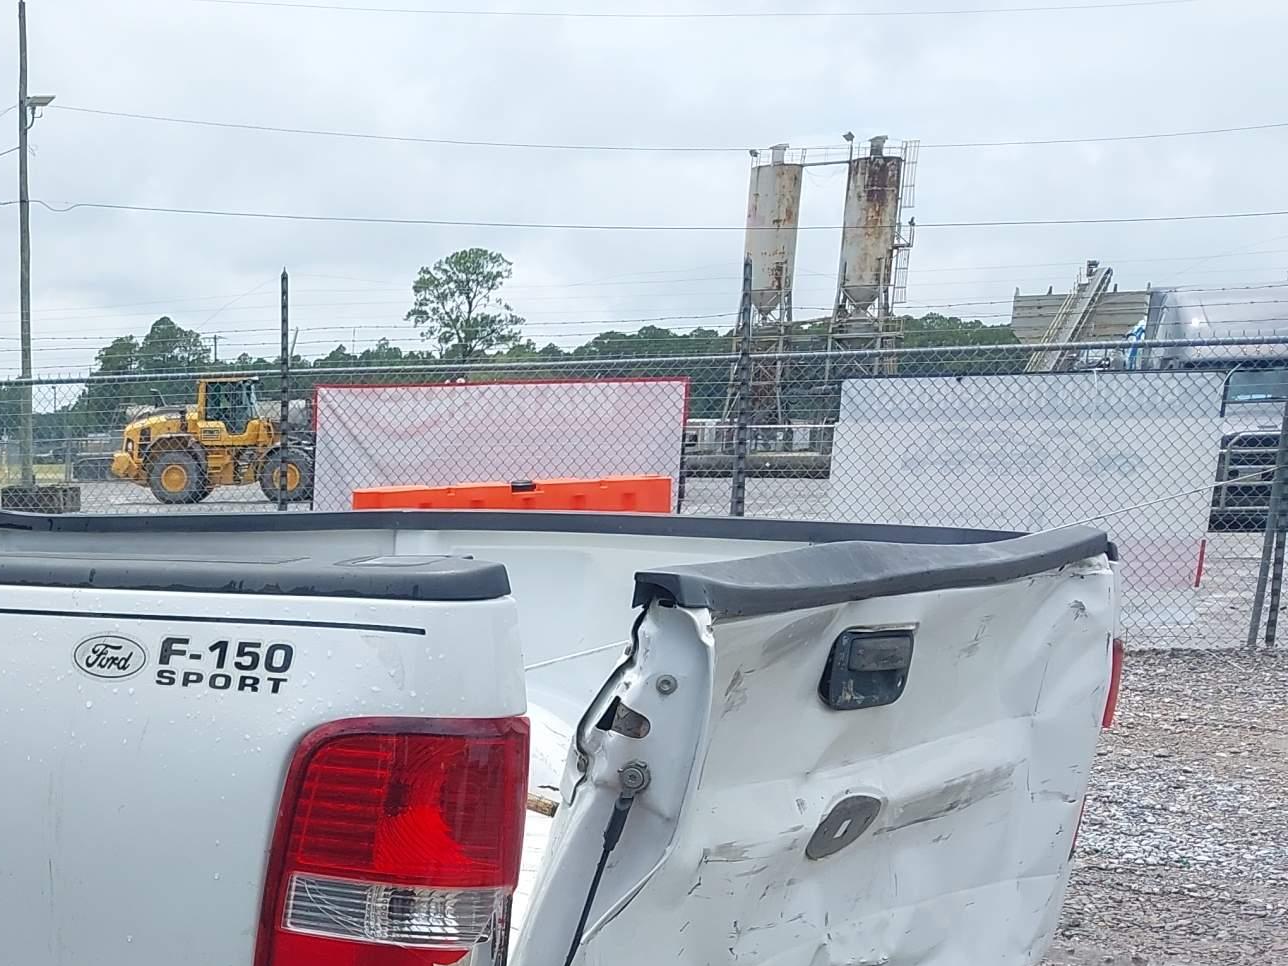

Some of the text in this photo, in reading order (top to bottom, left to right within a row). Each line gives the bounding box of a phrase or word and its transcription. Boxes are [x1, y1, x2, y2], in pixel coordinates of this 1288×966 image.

[85, 643, 134, 671] Ford
[158, 637, 294, 673] F-150
[155, 669, 288, 694] SPORT
